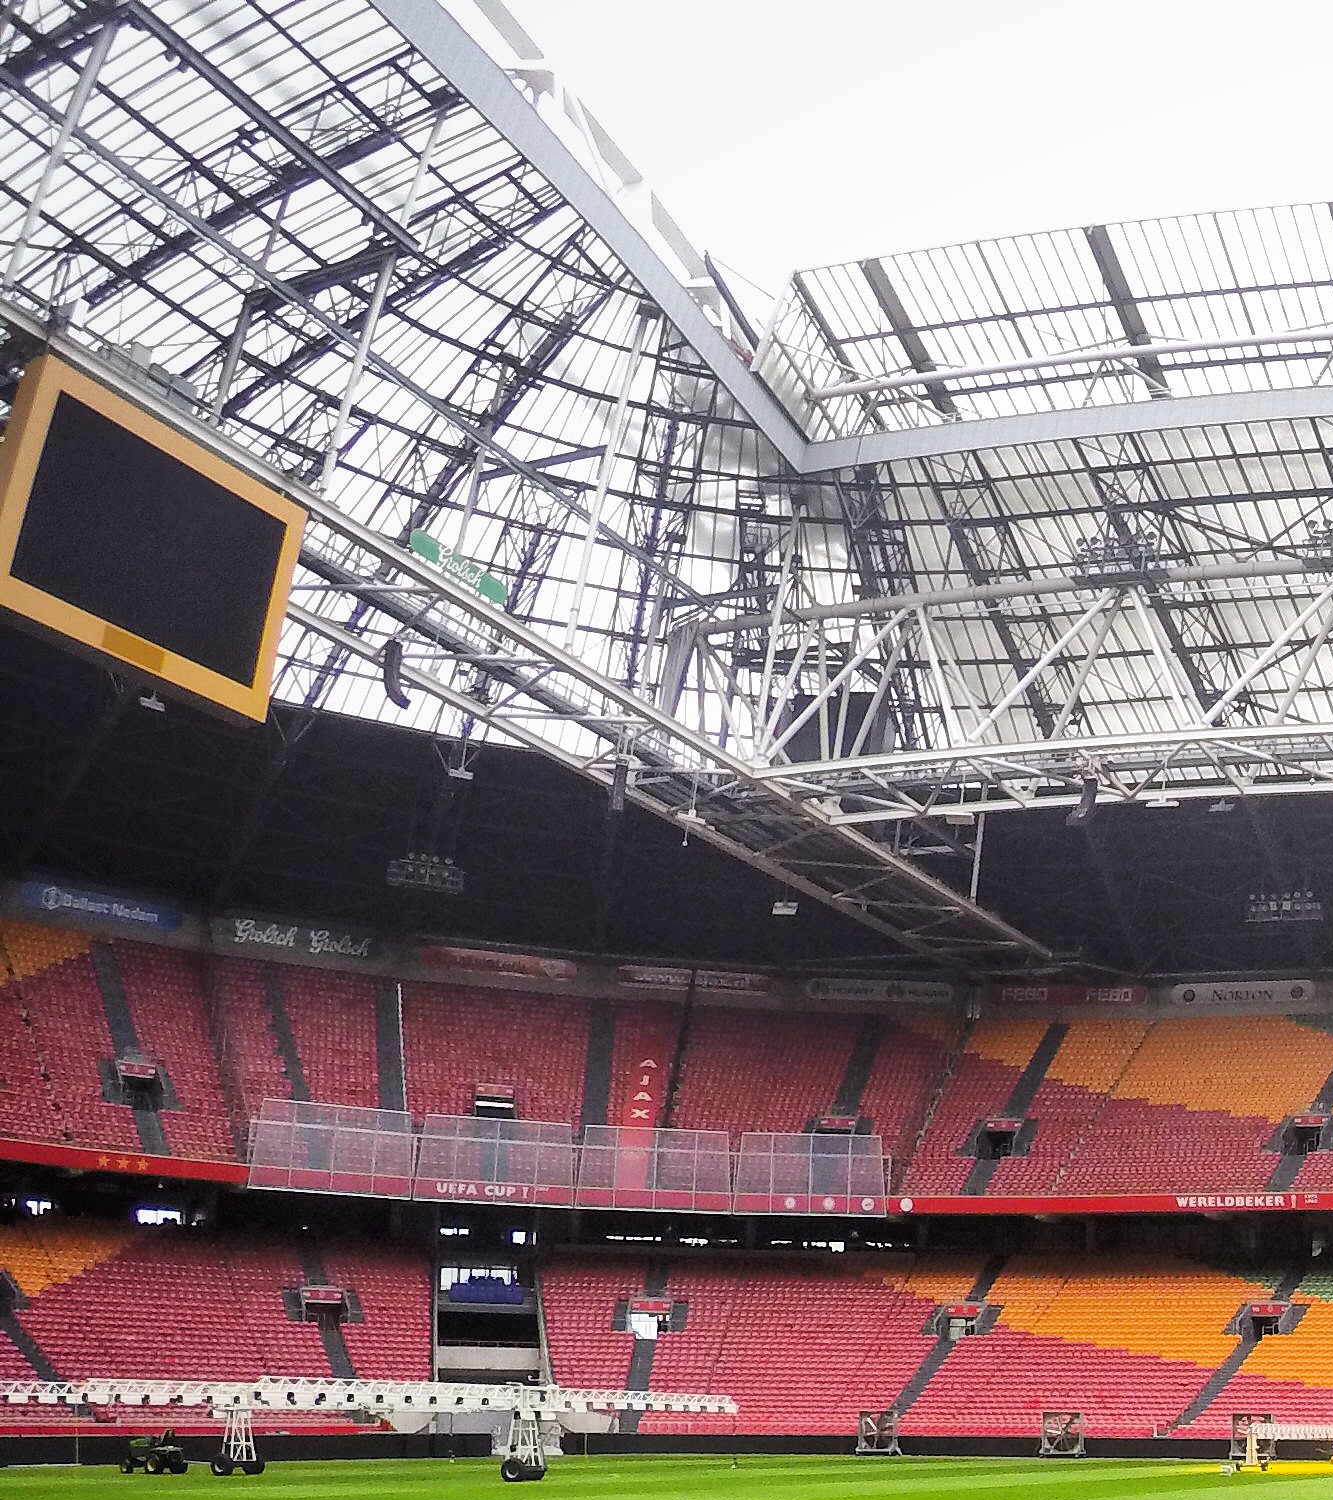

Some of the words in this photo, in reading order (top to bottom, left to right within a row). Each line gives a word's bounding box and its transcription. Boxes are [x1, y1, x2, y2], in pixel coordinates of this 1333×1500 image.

[438, 544, 483, 588] Grolsch
[233, 919, 298, 947] Grolsch
[310, 929, 372, 957] Grolsch
[629, 1058, 658, 1119] AJAX
[436, 1182, 478, 1196] UEFA
[484, 1185, 518, 1198] CUP
[1175, 1195, 1285, 1207] WERELDBEKER
